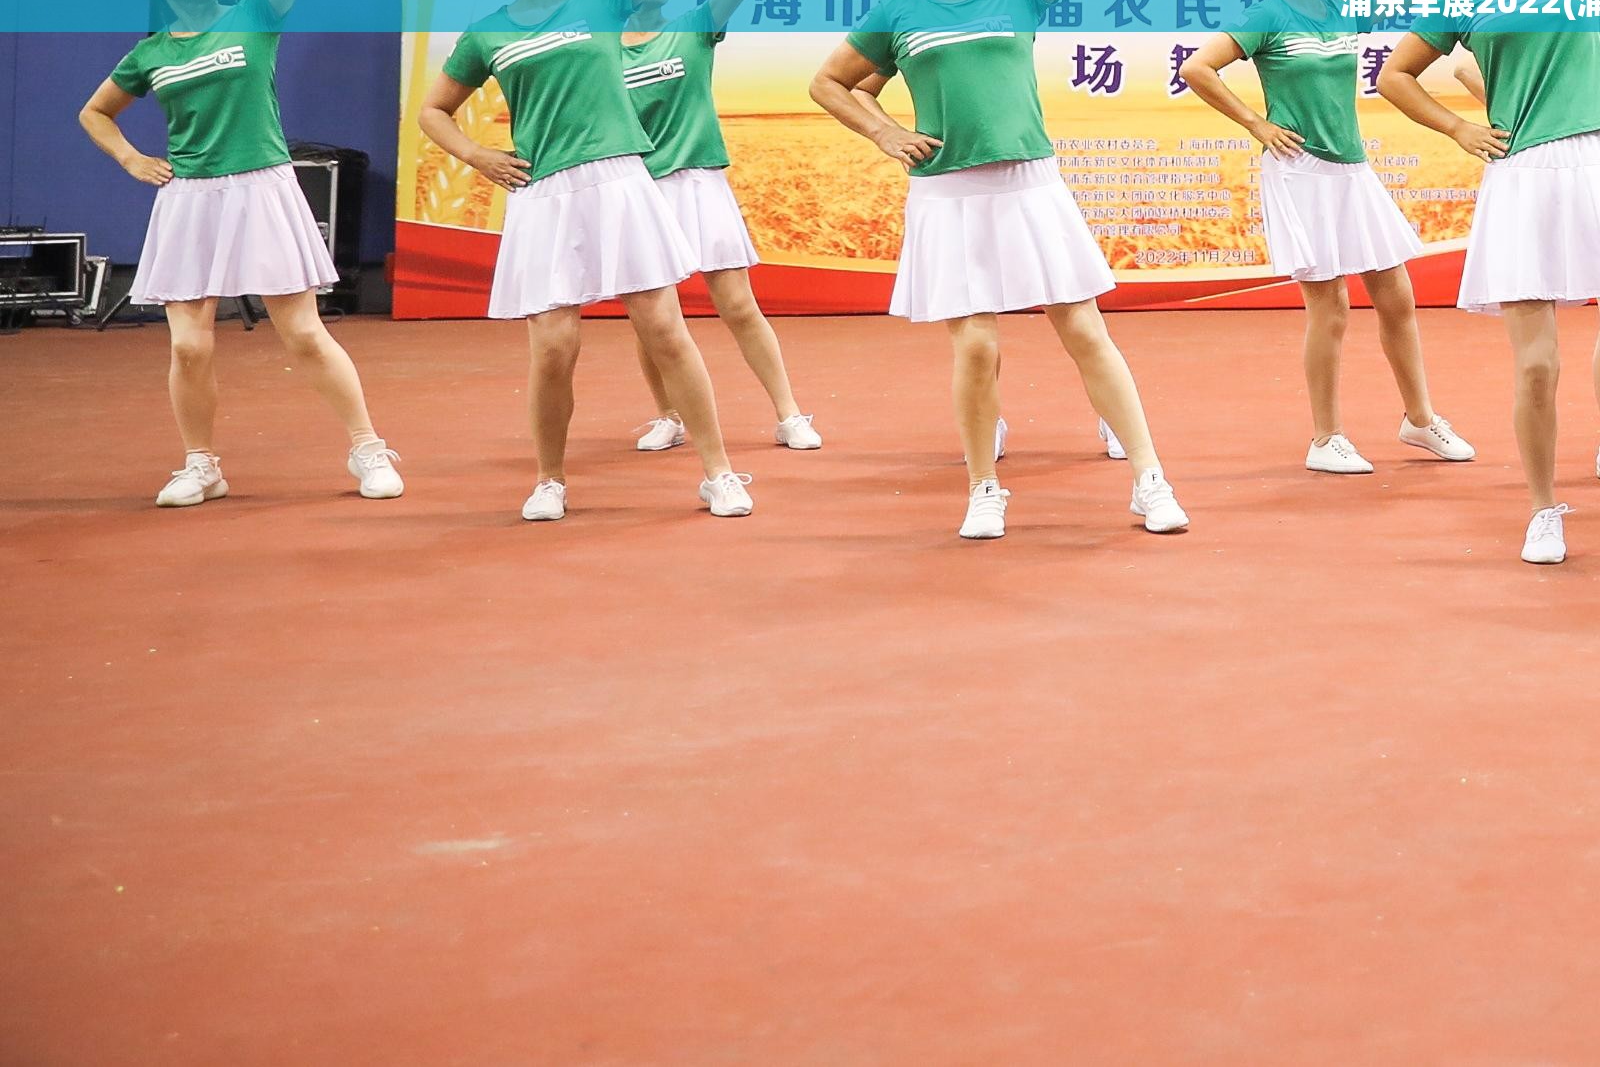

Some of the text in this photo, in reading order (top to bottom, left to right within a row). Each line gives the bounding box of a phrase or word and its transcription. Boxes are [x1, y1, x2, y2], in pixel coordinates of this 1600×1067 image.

[1051, 139, 1157, 150] 市农业农村委员会
[1060, 173, 1220, 184] 浦东新区体育管理指导中心
[1135, 250, 1255, 263] 2022年11月29日
